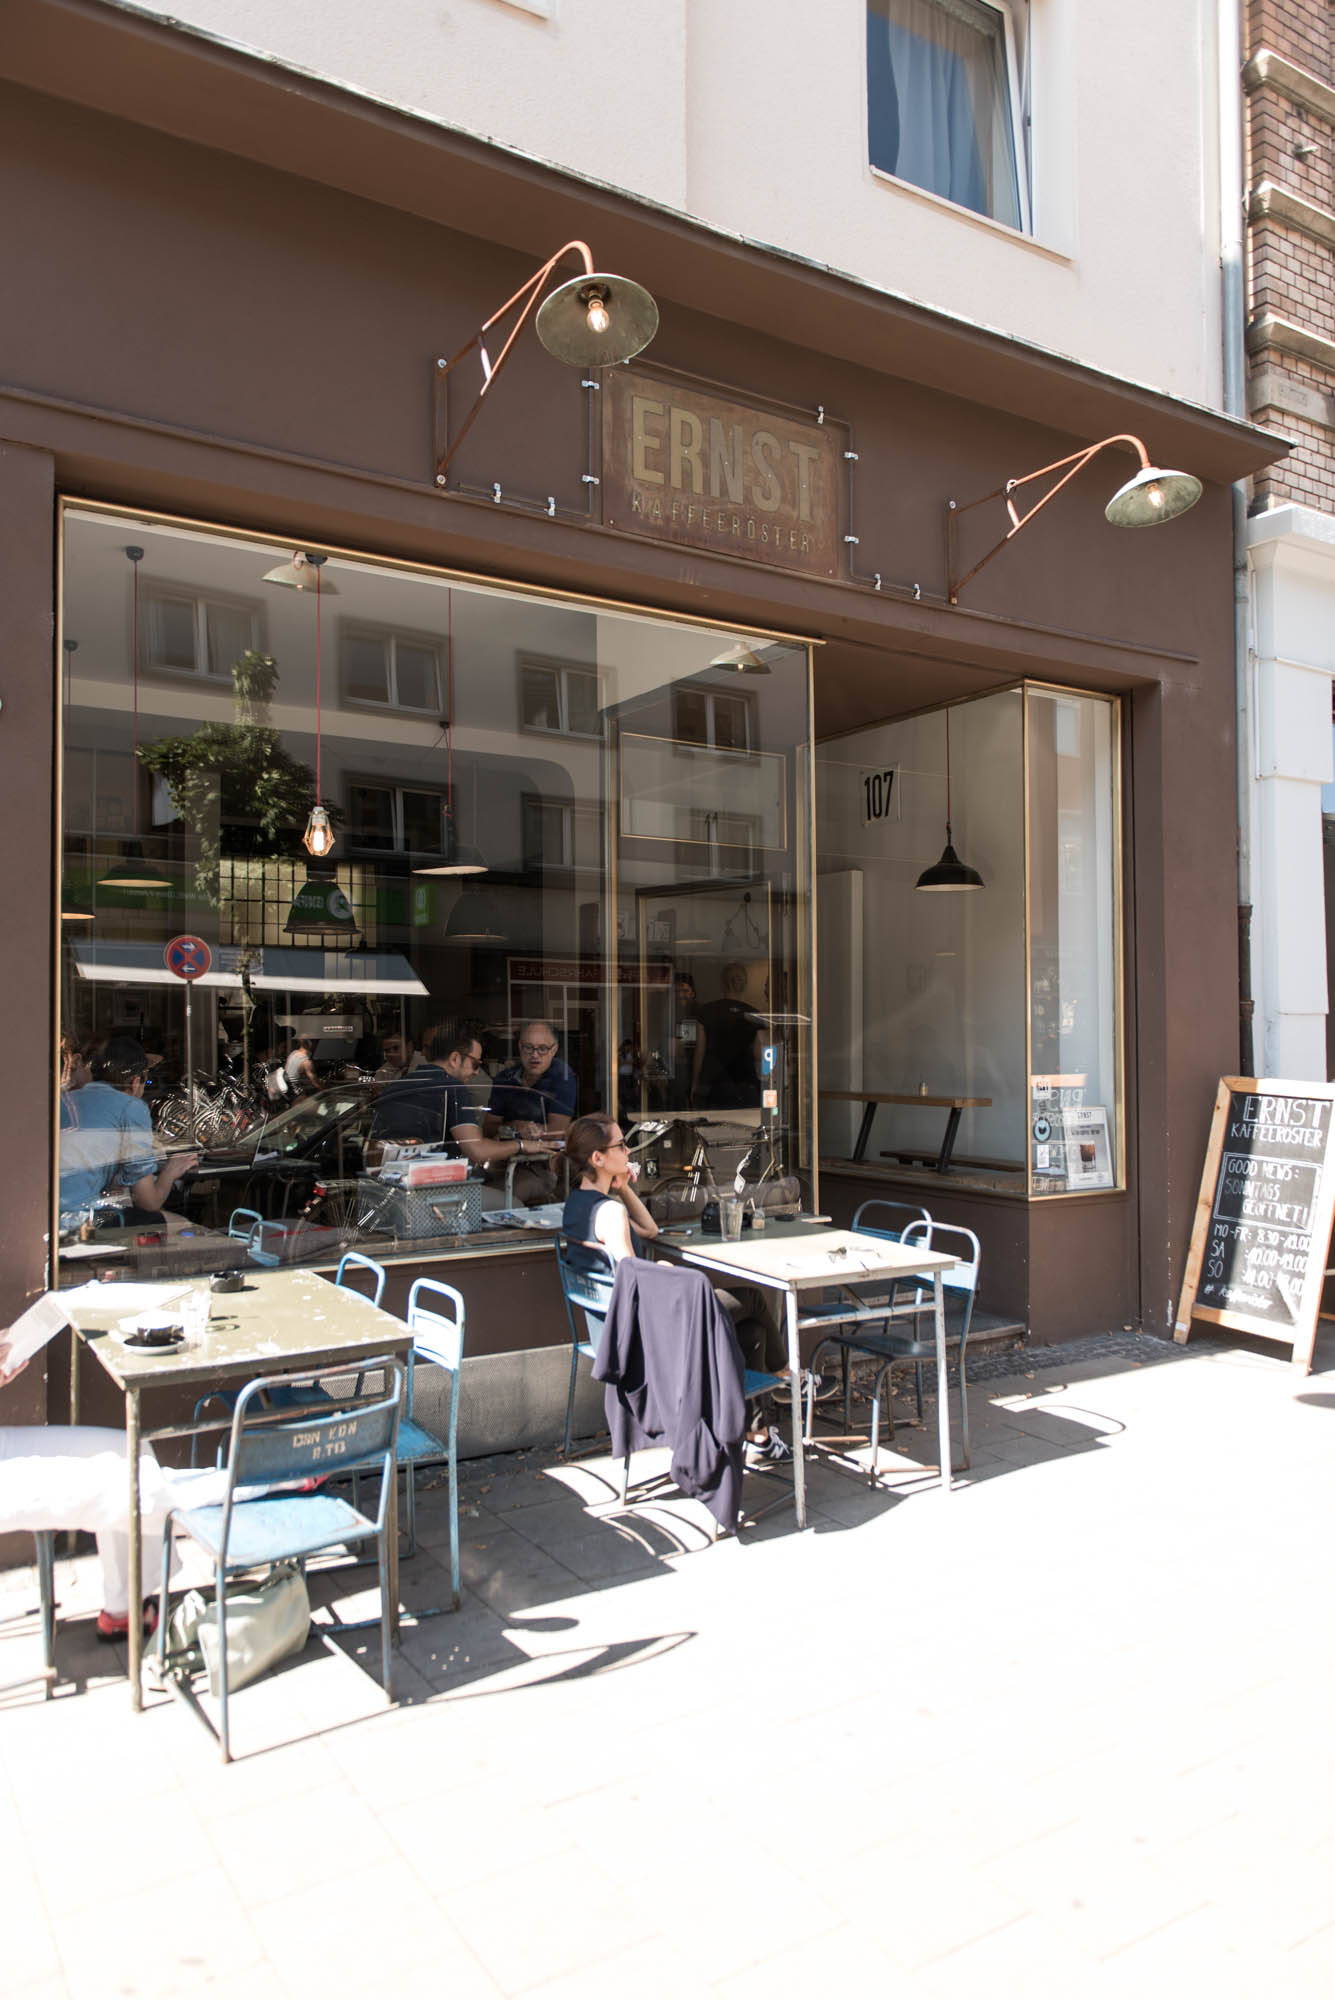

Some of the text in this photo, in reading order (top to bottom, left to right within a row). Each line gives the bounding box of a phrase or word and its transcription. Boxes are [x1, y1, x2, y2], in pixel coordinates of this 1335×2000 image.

[632, 394, 820, 524] ERNST
[631, 491, 810, 553] KAFFEERÖSTER
[864, 770, 894, 821] 107
[1243, 1095, 1330, 1128] ERNST
[1227, 1158, 1258, 1177] GOOD
[1211, 1240, 1226, 1260] SA
[1207, 1260, 1223, 1278] SO
